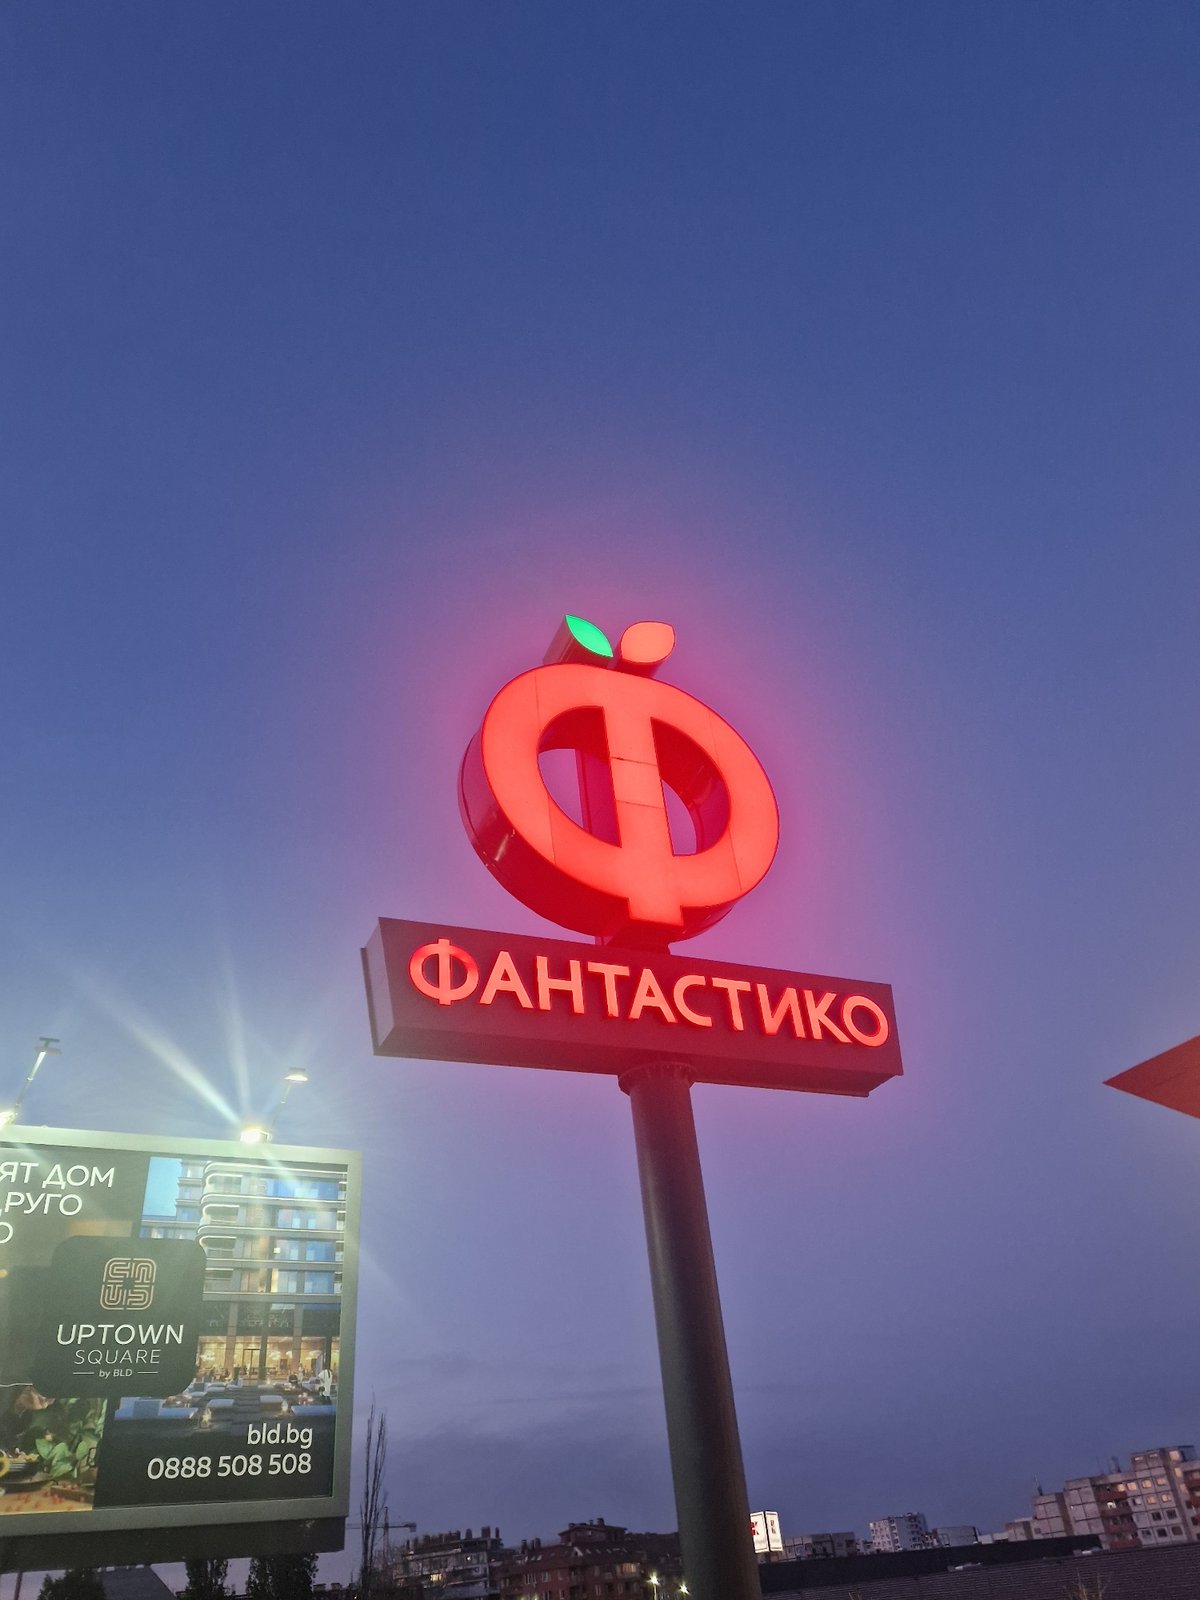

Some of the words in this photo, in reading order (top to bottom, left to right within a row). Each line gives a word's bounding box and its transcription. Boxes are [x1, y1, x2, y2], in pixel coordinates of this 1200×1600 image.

[408, 938, 890, 1048] ФАНТАСТИКО
[41, 1164, 115, 1190] ДОМ
[0, 1191, 83, 1217] РУГО
[57, 1324, 184, 1345] UPTOWN
[74, 1349, 161, 1365] SQUARE
[98, 1369, 111, 1379] by
[113, 1369, 133, 1377] BLD
[247, 1422, 313, 1450] bld.bg
[147, 1456, 212, 1480] 0888
[217, 1454, 263, 1477] 508
[268, 1452, 312, 1475] 508
